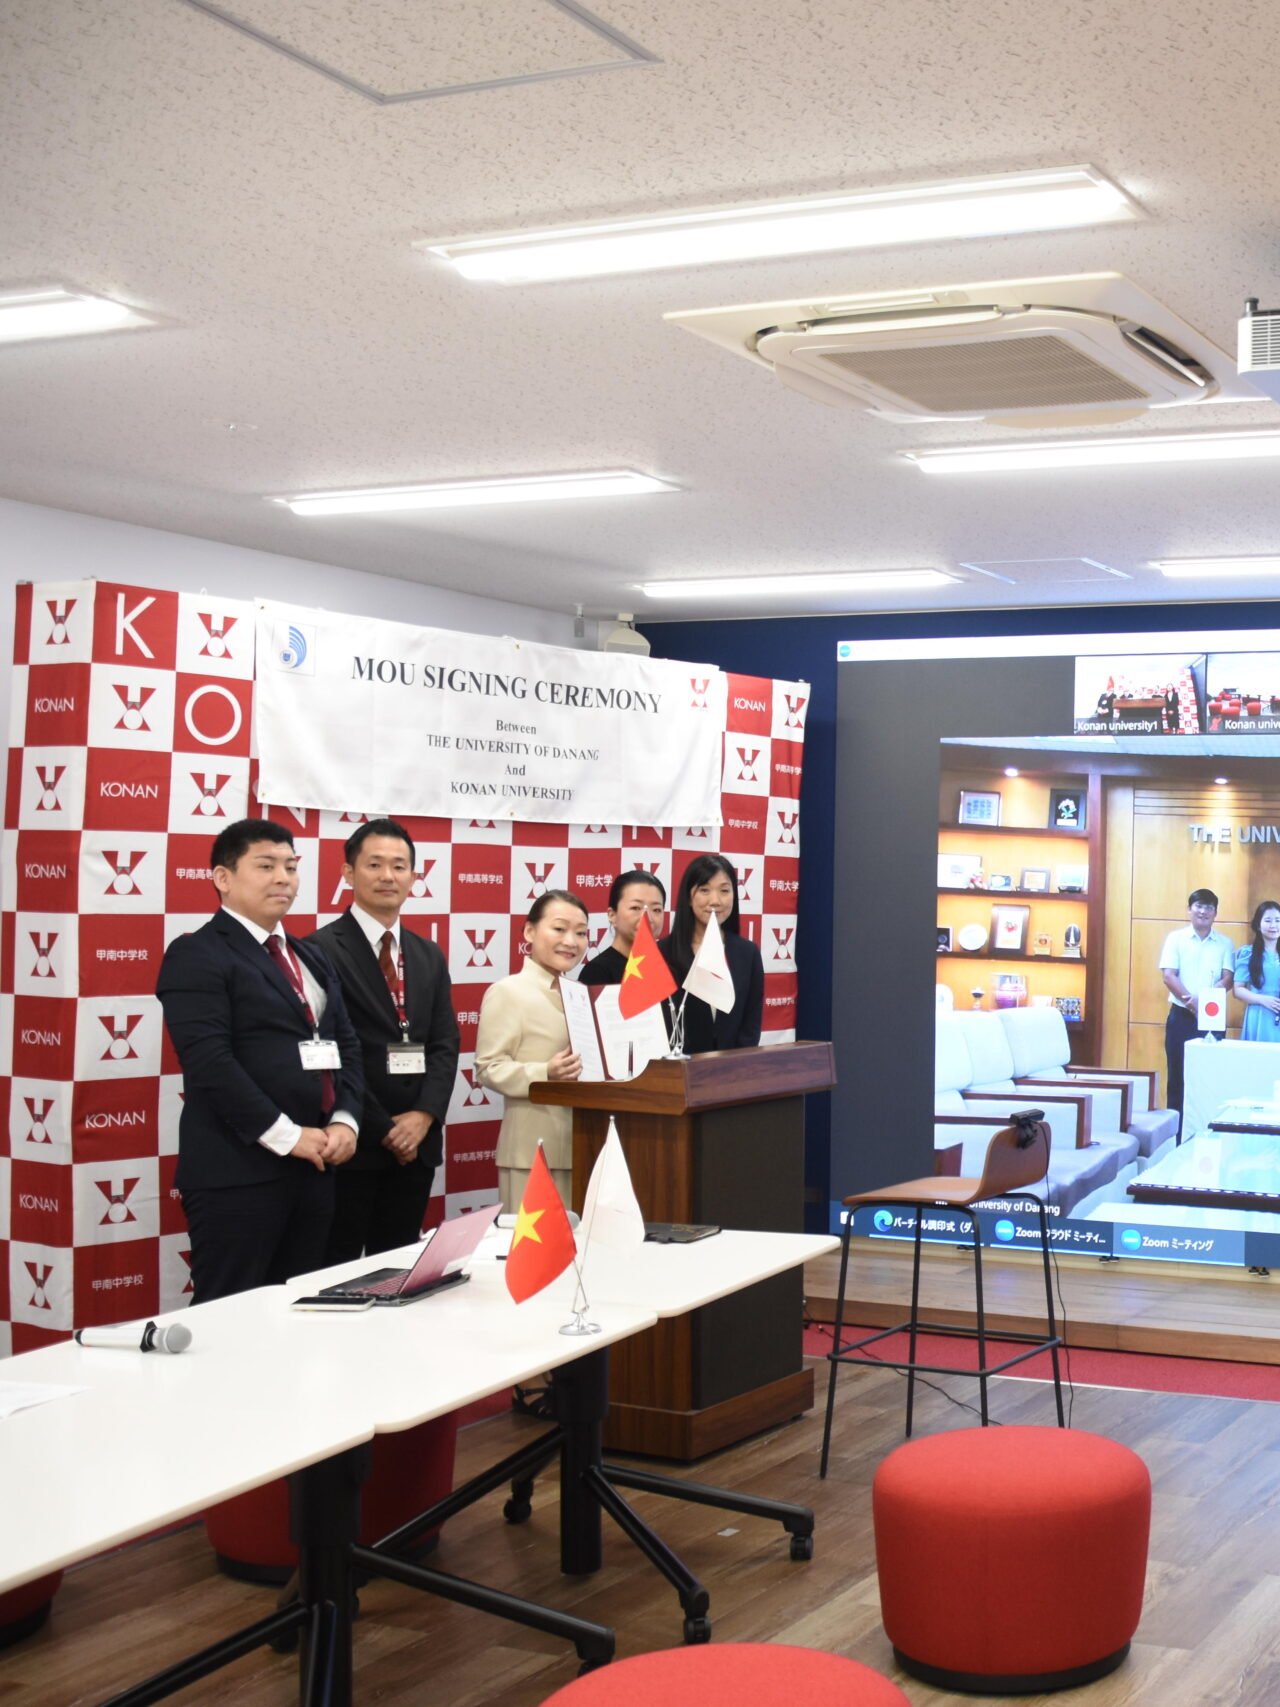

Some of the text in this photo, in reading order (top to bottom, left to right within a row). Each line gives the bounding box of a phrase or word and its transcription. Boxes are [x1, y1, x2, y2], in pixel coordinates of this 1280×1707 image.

[115, 592, 157, 660] K
[350, 656, 662, 714] MOU SIGNING CEREMONY
[34, 697, 75, 713] KONAN
[734, 697, 767, 713] KONAN
[184, 684, 243, 746] O
[496, 719, 537, 735] Between
[1077, 721, 1158, 732] Konan university1
[1225, 719, 1256, 730] Konan
[427, 734, 599, 761] THE UNIVERSITY OF DANANG
[504, 764, 526, 777] And
[100, 782, 159, 799] KONAN
[450, 781, 575, 801] KONAN UNIVERSITY
[1189, 823, 1231, 844] THE
[25, 863, 67, 879] KONAN
[458, 873, 503, 885] 甲南高等学校
[576, 874, 614, 888] 甲南大学
[769, 880, 799, 892] 甲南大学
[96, 948, 148, 962] 甲南中学校
[21, 1030, 61, 1047] KONAN
[85, 1111, 146, 1129] KONAN
[19, 1194, 59, 1213] KONAN
[1013, 1200, 1025, 1212] of
[1015, 1227, 1042, 1239] Zoom
[1142, 1236, 1214, 1252] Zoom ミーティング
[92, 1274, 144, 1291] 甲南中学校
